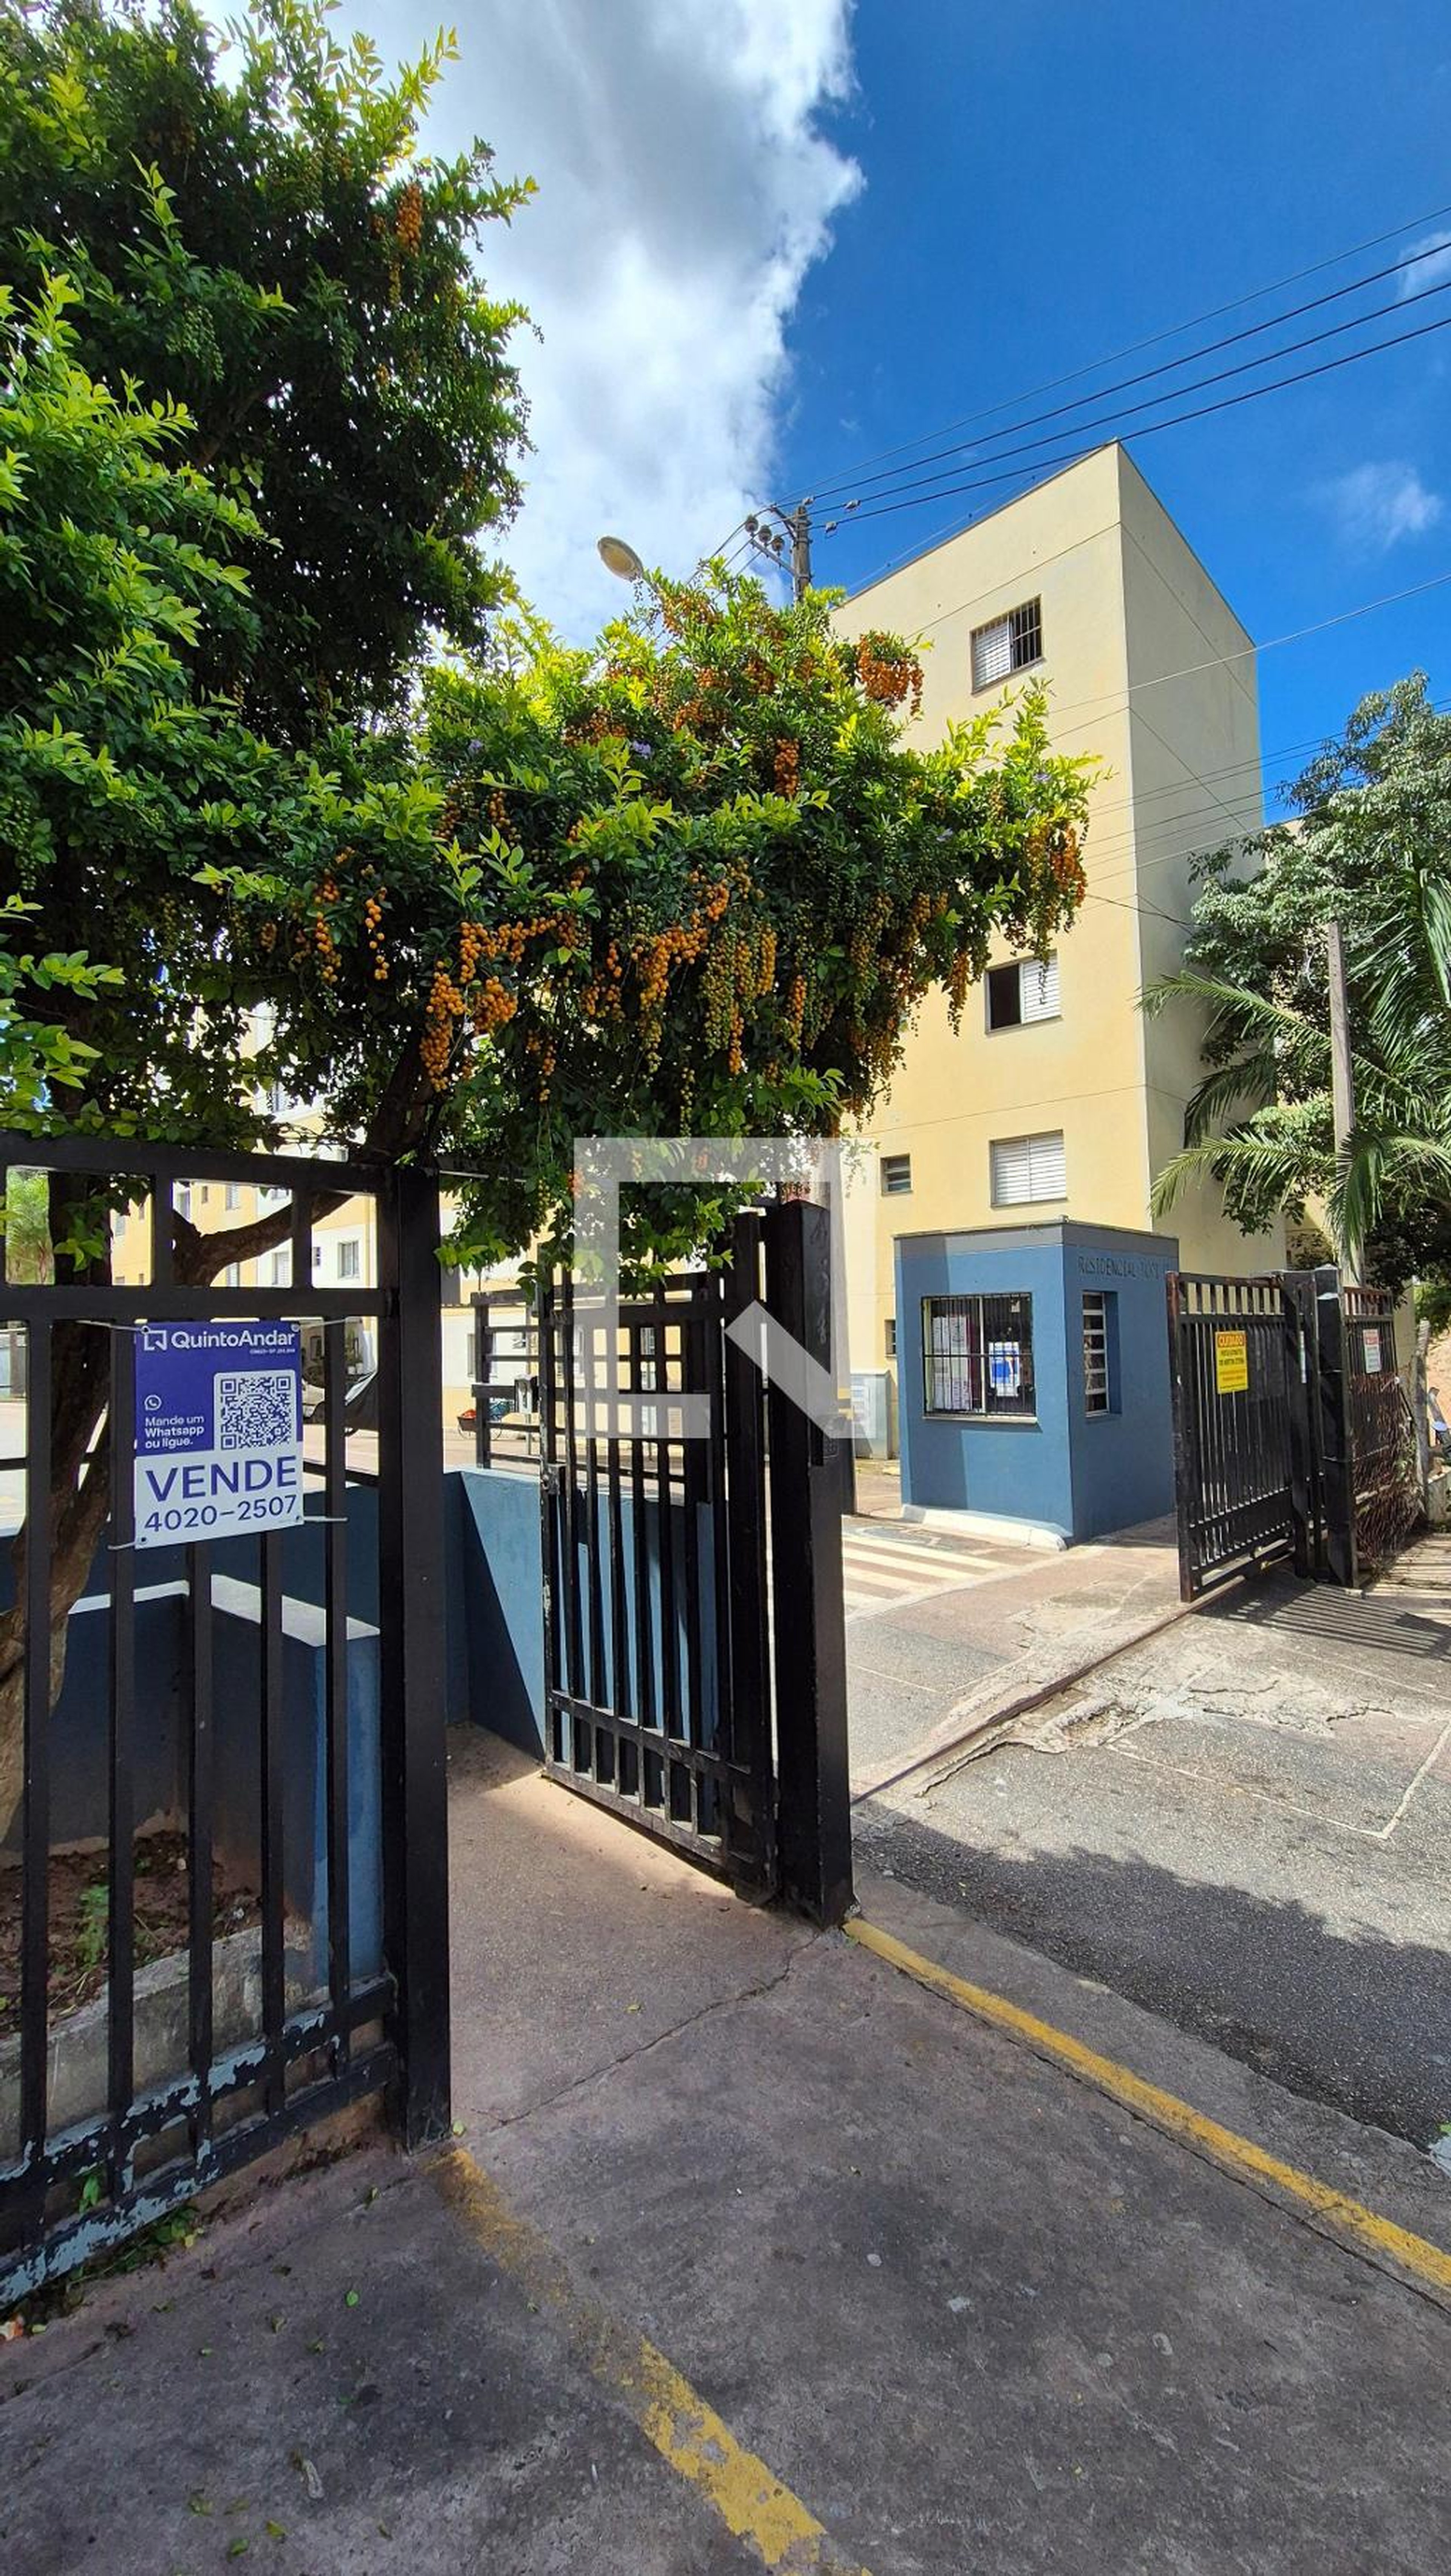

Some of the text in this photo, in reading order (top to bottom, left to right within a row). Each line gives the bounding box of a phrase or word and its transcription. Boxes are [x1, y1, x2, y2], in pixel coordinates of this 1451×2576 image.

[171, 1330, 295, 1349] QuintoAndar
[145, 1415, 185, 1427] Mande
[144, 1426, 204, 1438] Whatsapp
[145, 1438, 193, 1449] ou ligue.
[145, 1455, 297, 1503] VENDE
[144, 1494, 297, 1532] 4020-2507
